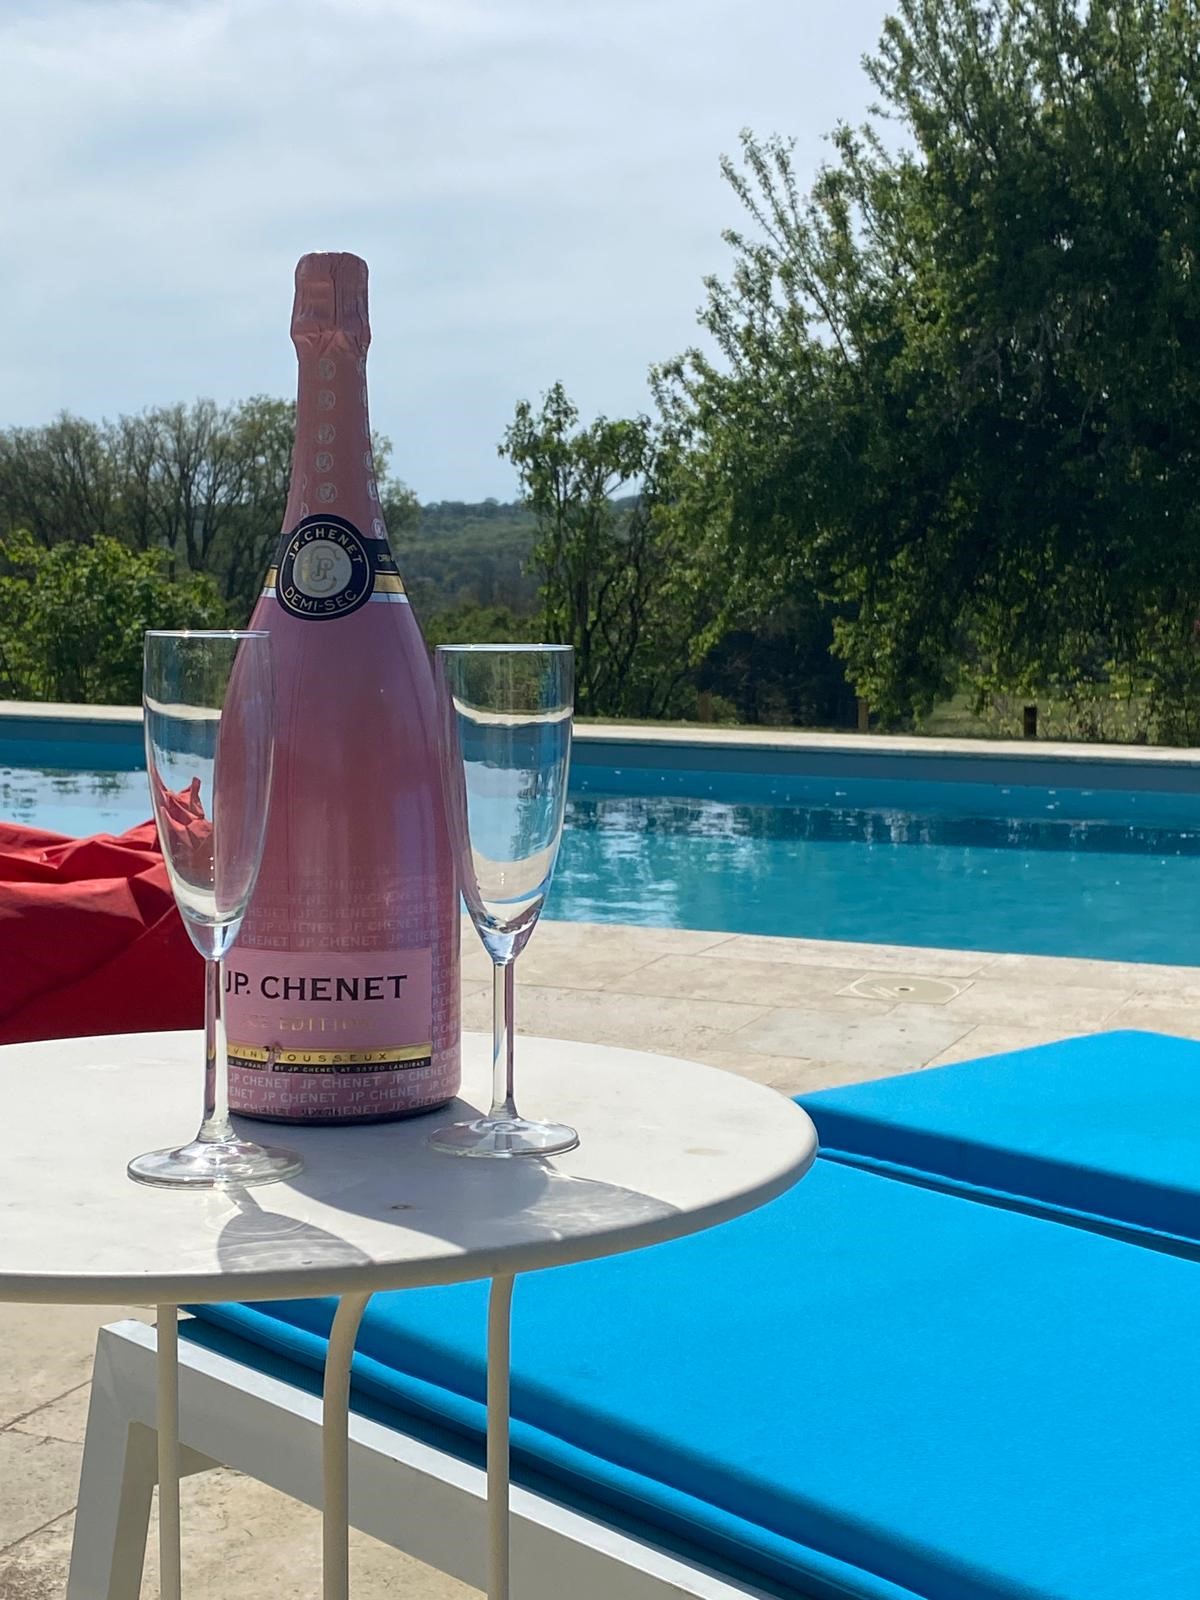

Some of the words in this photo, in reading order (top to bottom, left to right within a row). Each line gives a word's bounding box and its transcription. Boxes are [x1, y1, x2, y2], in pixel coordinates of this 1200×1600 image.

[284, 586, 357, 612] DEMI-SEC
[226, 970, 251, 995] JP.
[260, 974, 408, 1001] CHENET
[260, 1052, 386, 1063] OUSSEUX
[242, 1074, 290, 1090] CHENET
[300, 1079, 317, 1090] JP
[321, 1077, 381, 1090] CHENET
[261, 1091, 276, 1102] JP
[280, 1092, 338, 1104] CHENET
[369, 1084, 423, 1102] CHENET
